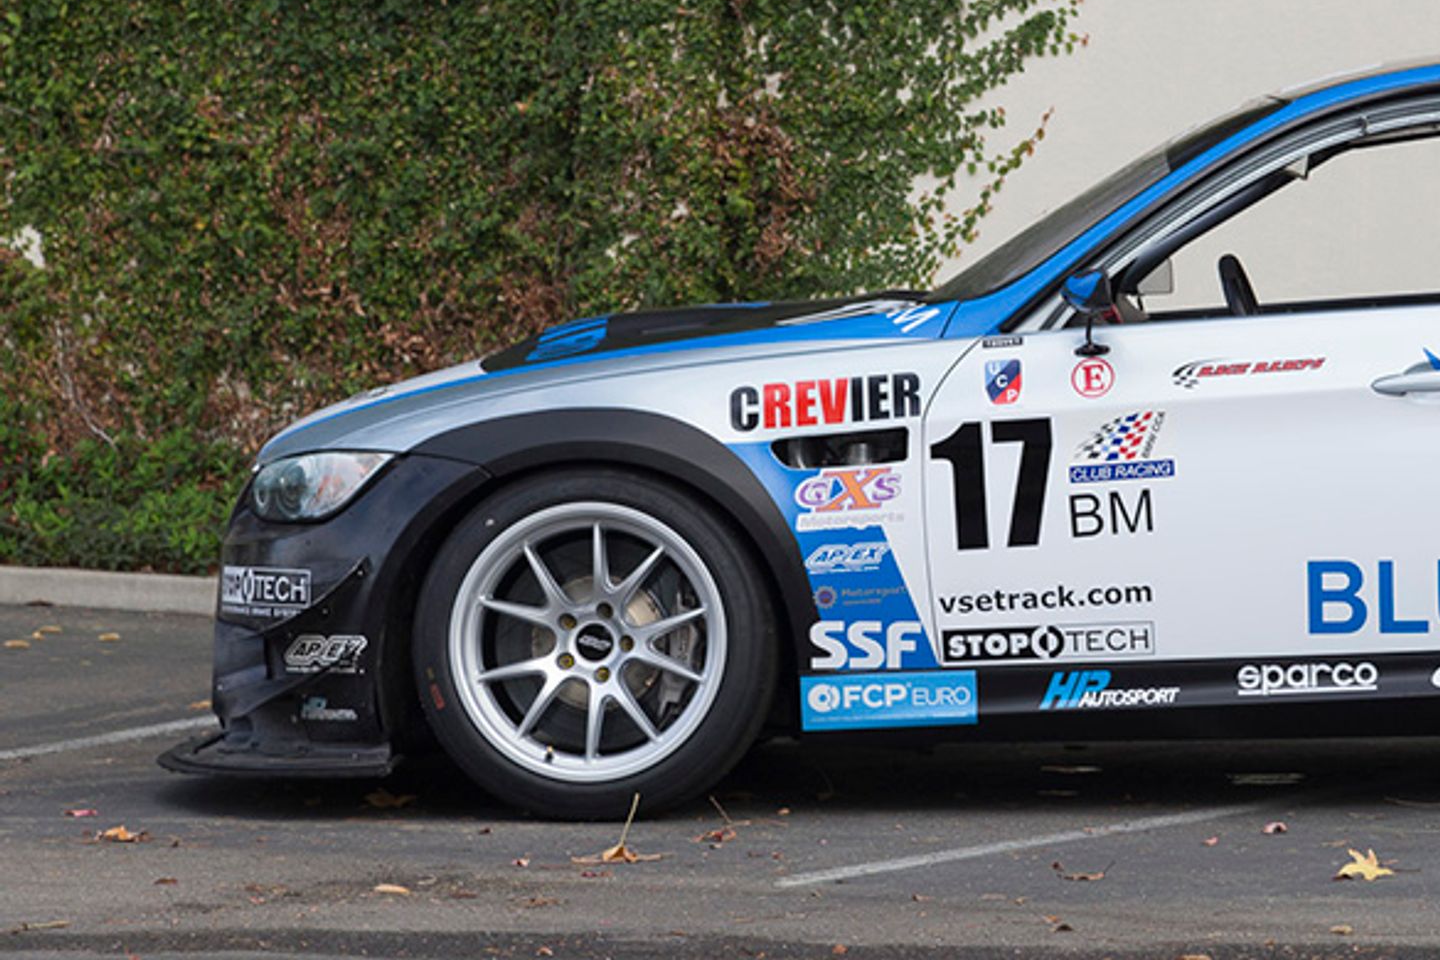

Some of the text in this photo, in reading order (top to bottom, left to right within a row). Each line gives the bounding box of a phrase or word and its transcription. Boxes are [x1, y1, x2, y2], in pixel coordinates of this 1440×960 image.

[1081, 364, 1105, 390] E
[730, 372, 921, 432] CREVIER
[930, 417, 1052, 551] 17
[1073, 461, 1171, 482] CLUB RACING
[1069, 488, 1153, 538] BM
[808, 543, 888, 565] APEX
[939, 585, 1153, 613] vsetrack.com
[809, 621, 922, 669] SSF
[1040, 670, 1180, 710] HP AUTOSPORT
[1238, 662, 1378, 693] sparco
[843, 683, 971, 708] FCP EURO
